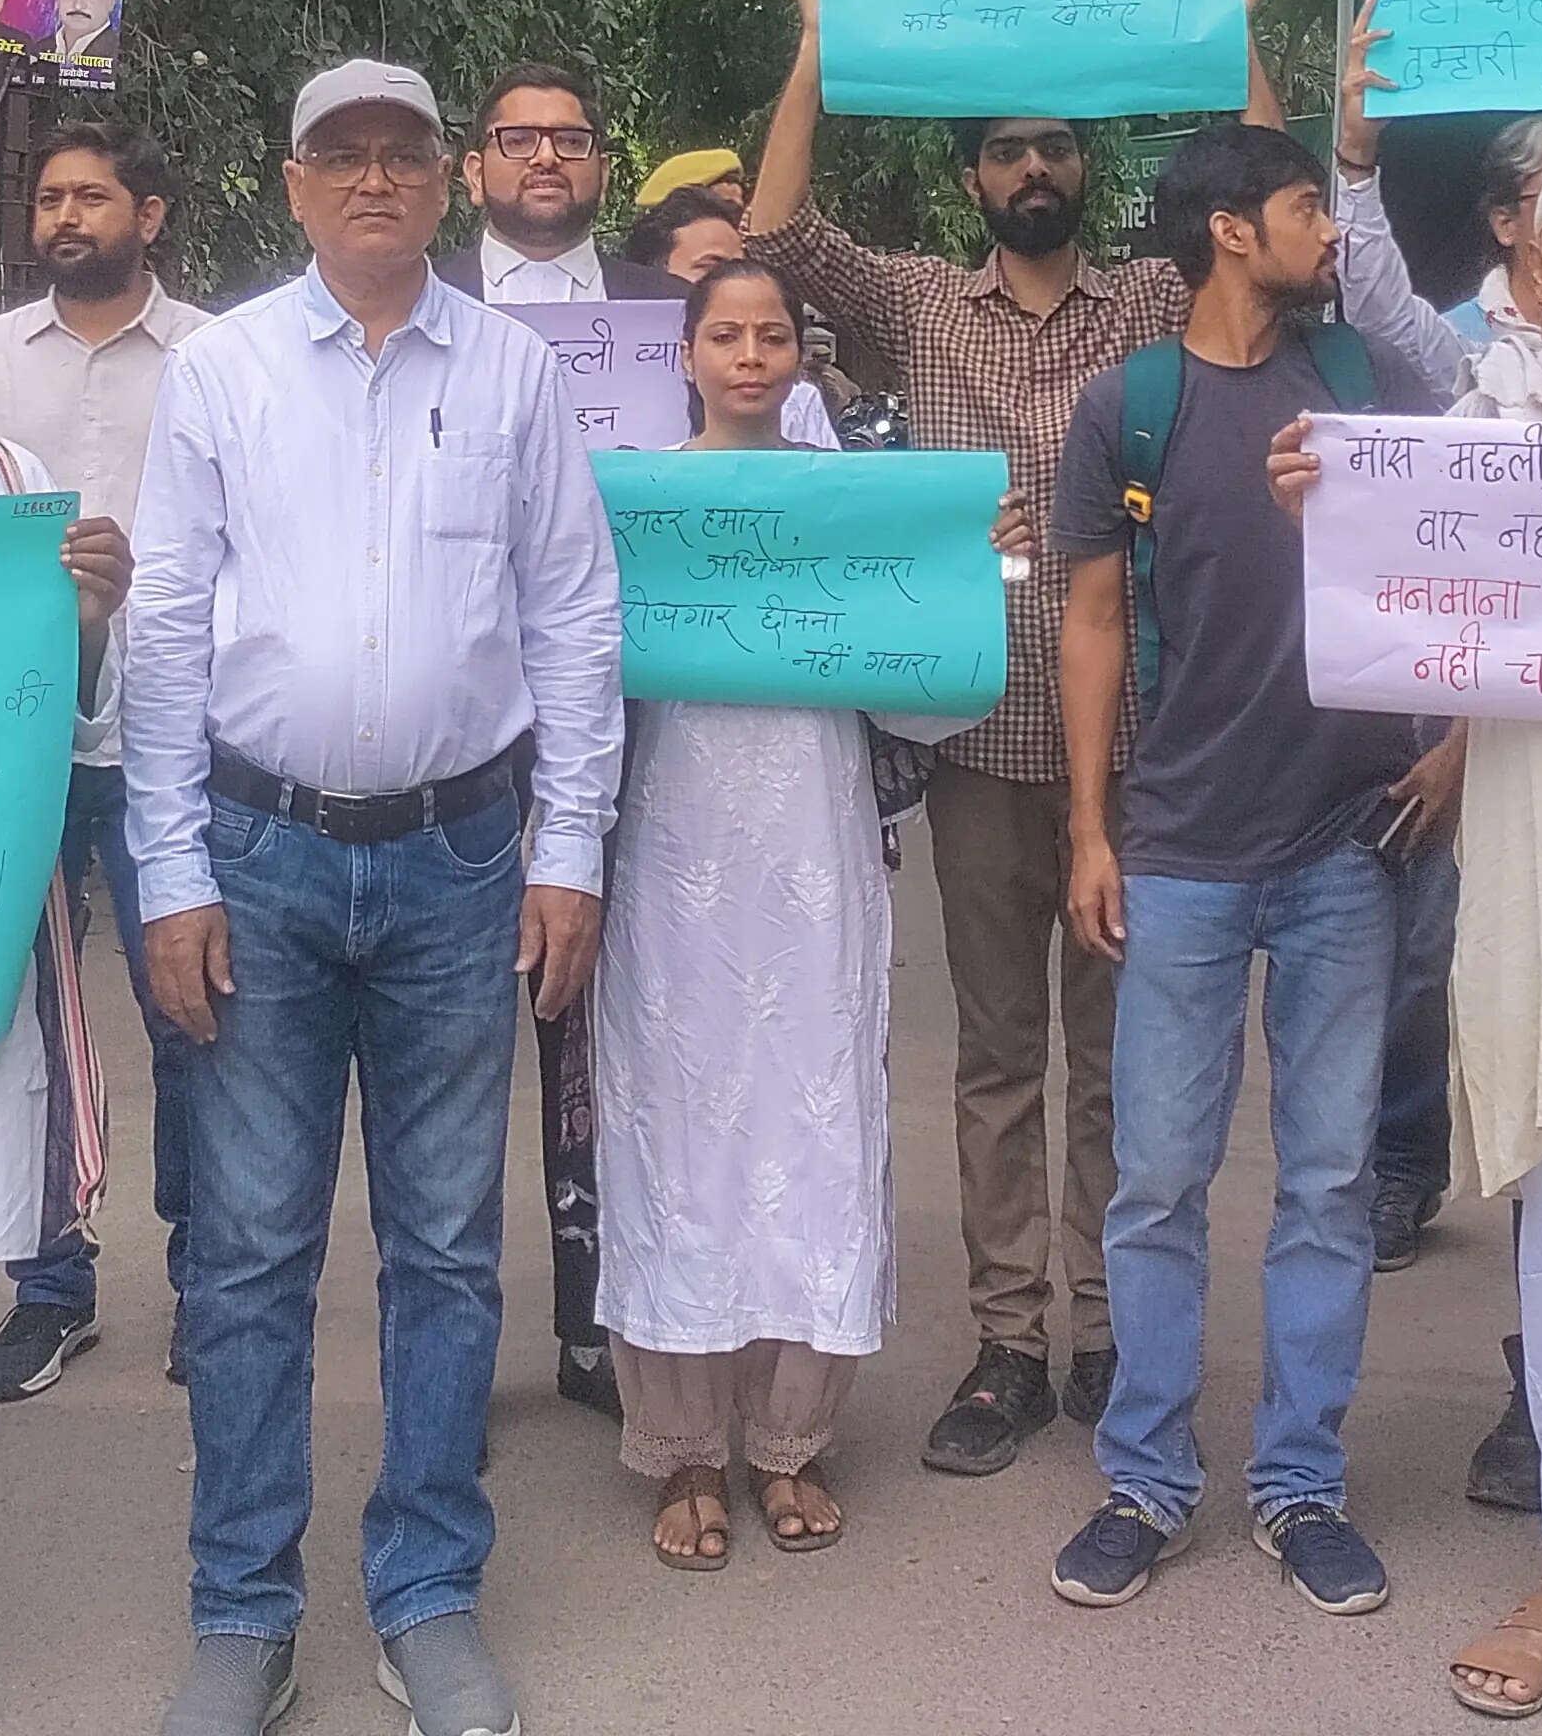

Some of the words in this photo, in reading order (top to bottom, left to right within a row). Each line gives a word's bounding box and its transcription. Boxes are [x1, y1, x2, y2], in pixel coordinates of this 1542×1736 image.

[975, 6, 1027, 29] मत
[1399, 30, 1526, 91] तुम्हारी
[1346, 428, 1425, 481] मांस
[12, 499, 73, 515] LIBERTY
[611, 507, 694, 557] शहर
[1415, 509, 1479, 553] वार
[844, 555, 921, 604] हमारा
[1374, 574, 1541, 621] मनमाना
[792, 643, 853, 678] नहीं
[863, 651, 941, 702] गवारा
[1413, 620, 1491, 691] नहीं
[4, 668, 55, 720] की
